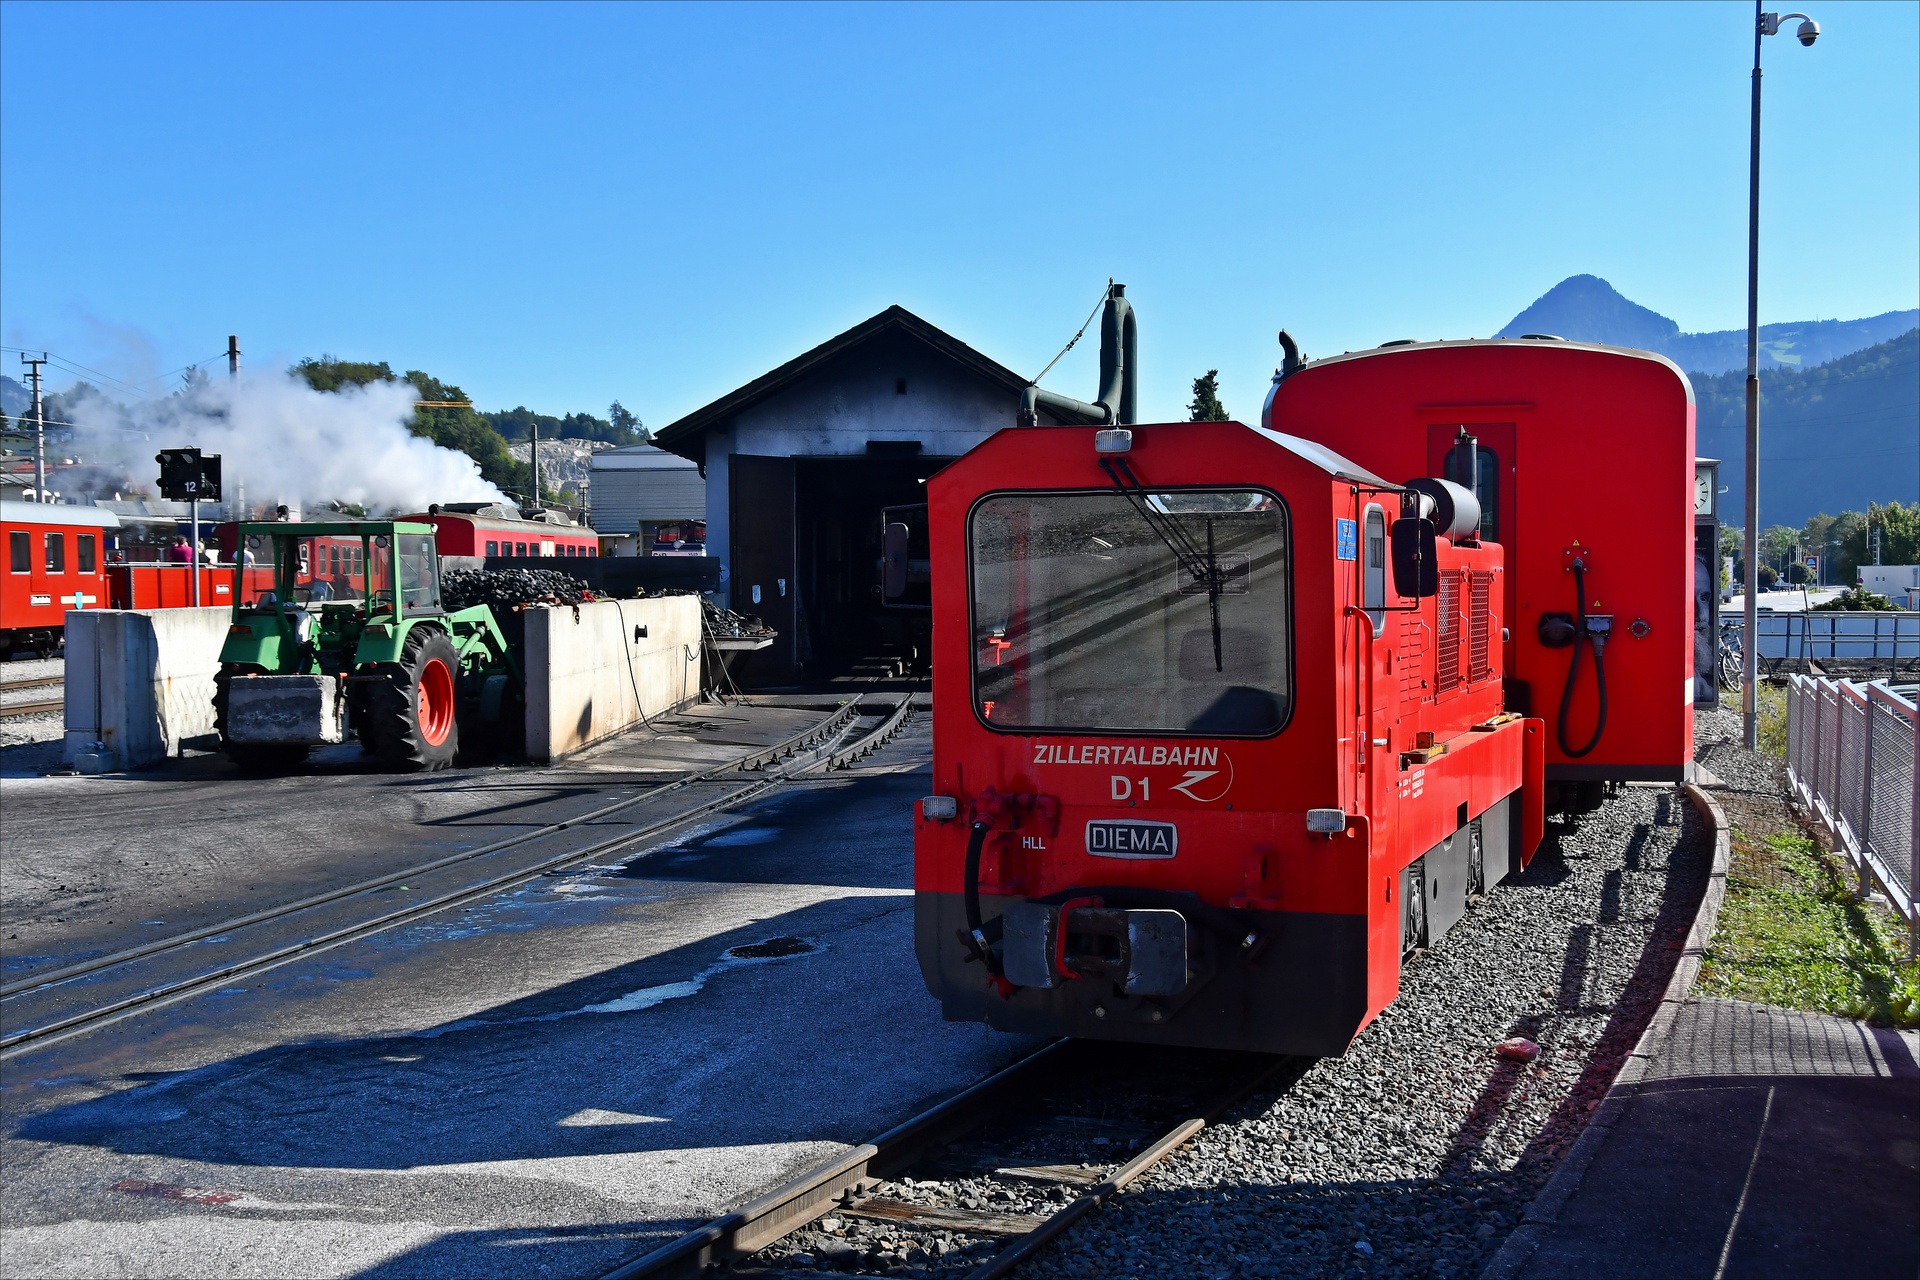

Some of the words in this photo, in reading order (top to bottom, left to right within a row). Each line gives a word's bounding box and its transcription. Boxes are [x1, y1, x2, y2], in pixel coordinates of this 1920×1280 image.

[184, 481, 196, 492] 12
[1033, 744, 1218, 766] ZILLERTALBAHN
[1022, 836, 1046, 850] HLL
[1092, 826, 1170, 852] DIEMA
